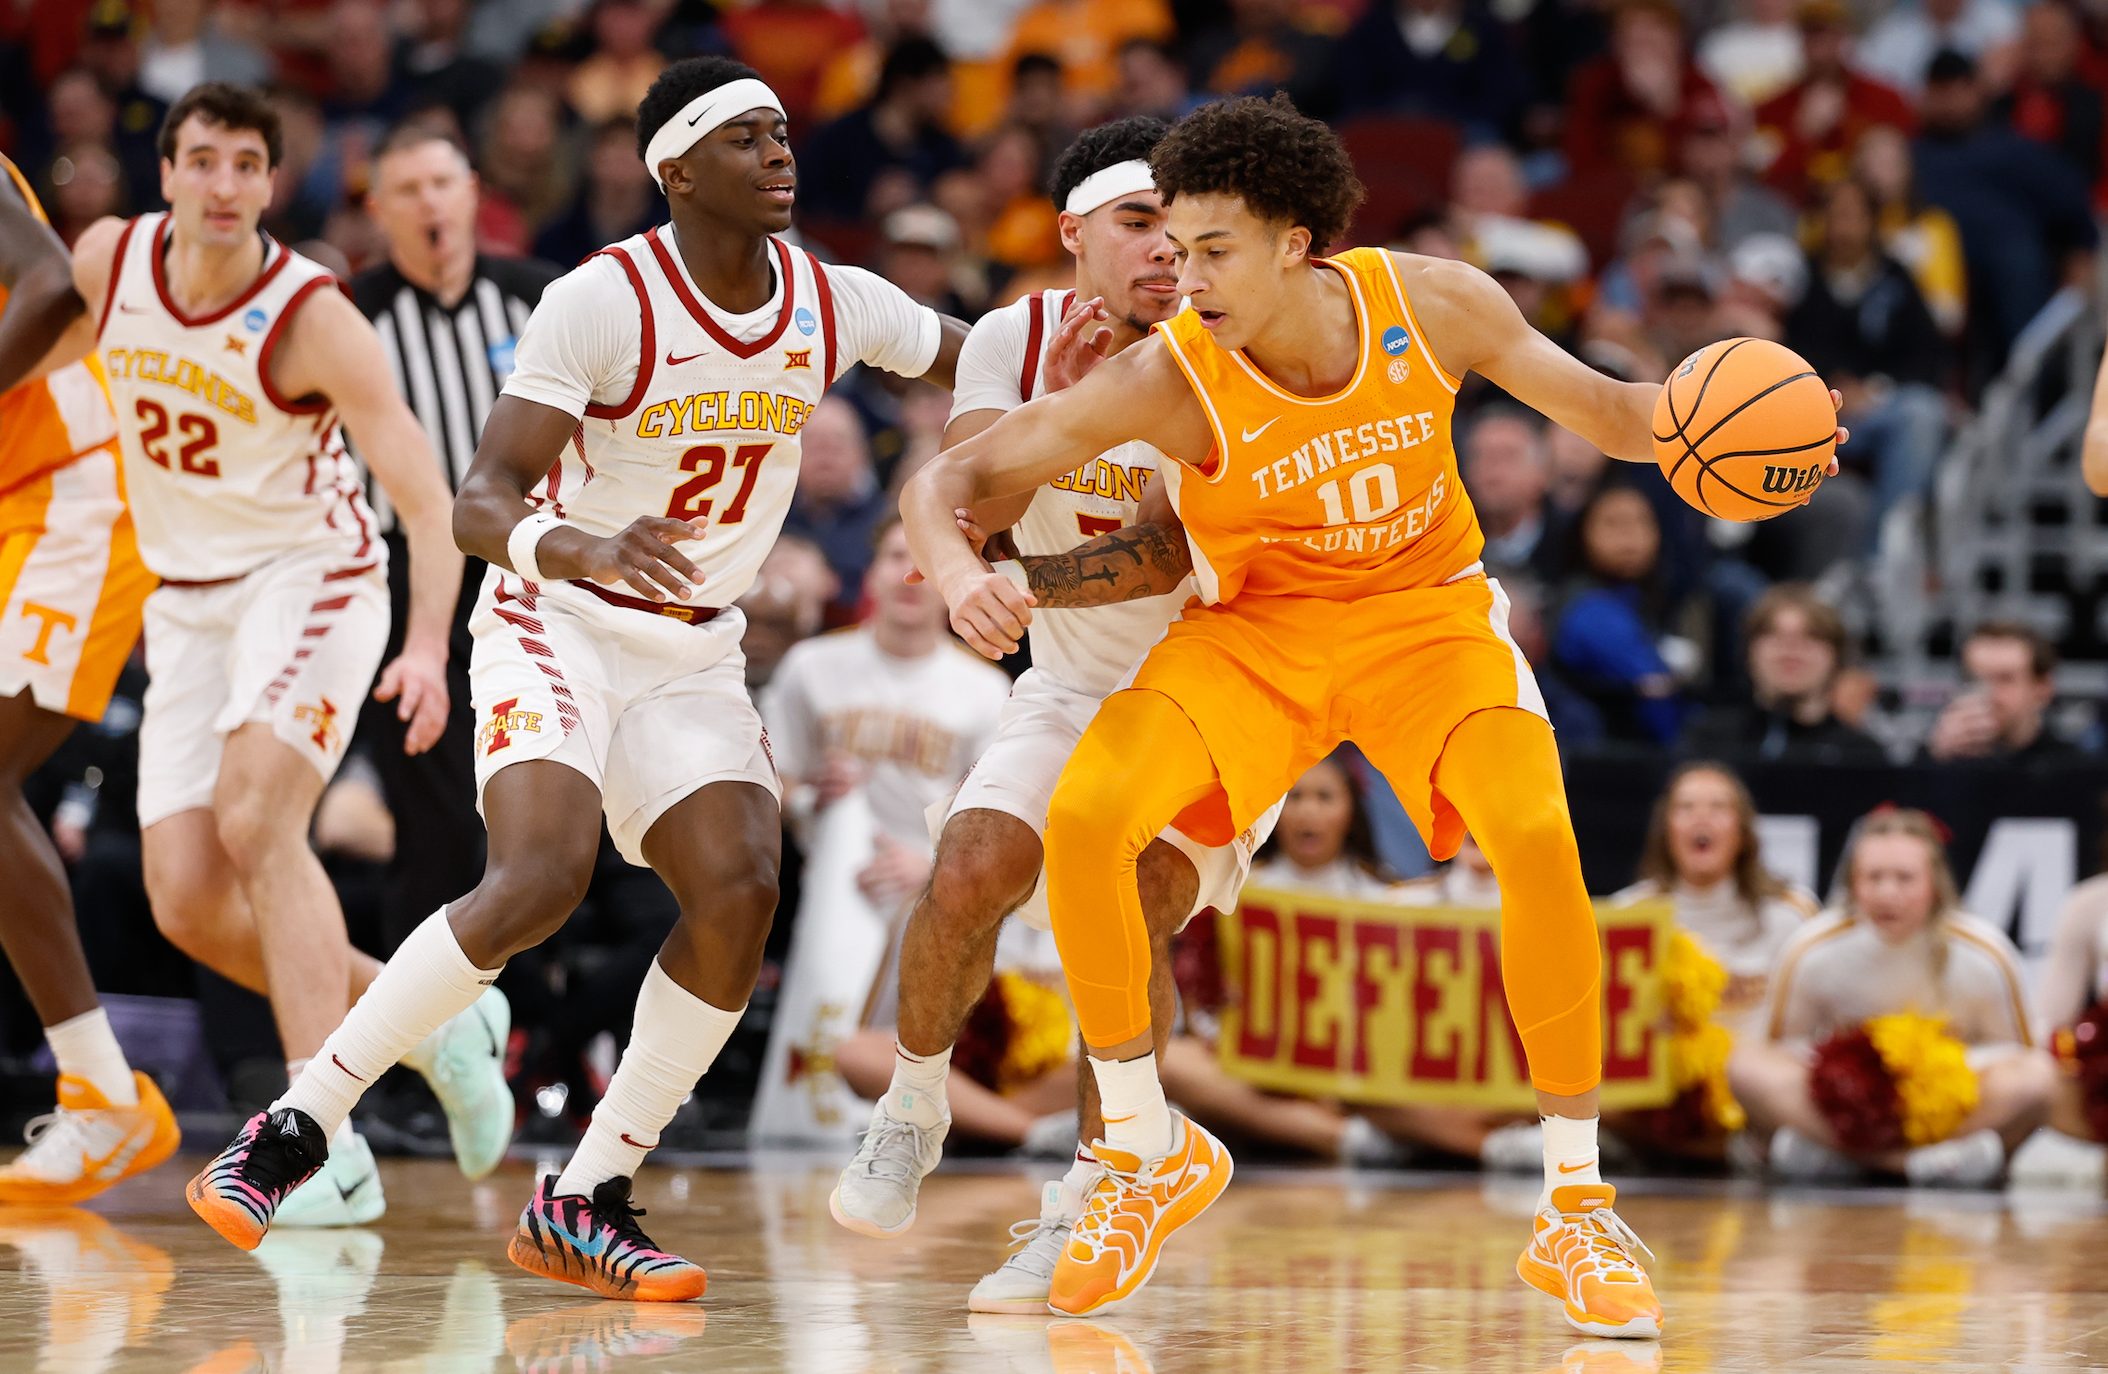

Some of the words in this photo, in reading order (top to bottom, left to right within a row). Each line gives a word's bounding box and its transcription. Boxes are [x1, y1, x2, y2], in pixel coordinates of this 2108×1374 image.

[1386, 335, 1409, 351] NCAA
[1389, 360, 1409, 382] SEC
[107, 347, 259, 425] CYCLONES
[134, 397, 222, 478] 22
[1250, 410, 1435, 500] TENNESSEE
[663, 441, 777, 526] 27
[1316, 462, 1400, 528] 10
[21, 600, 77, 667] T
[1236, 904, 1654, 1083] DEFENE
